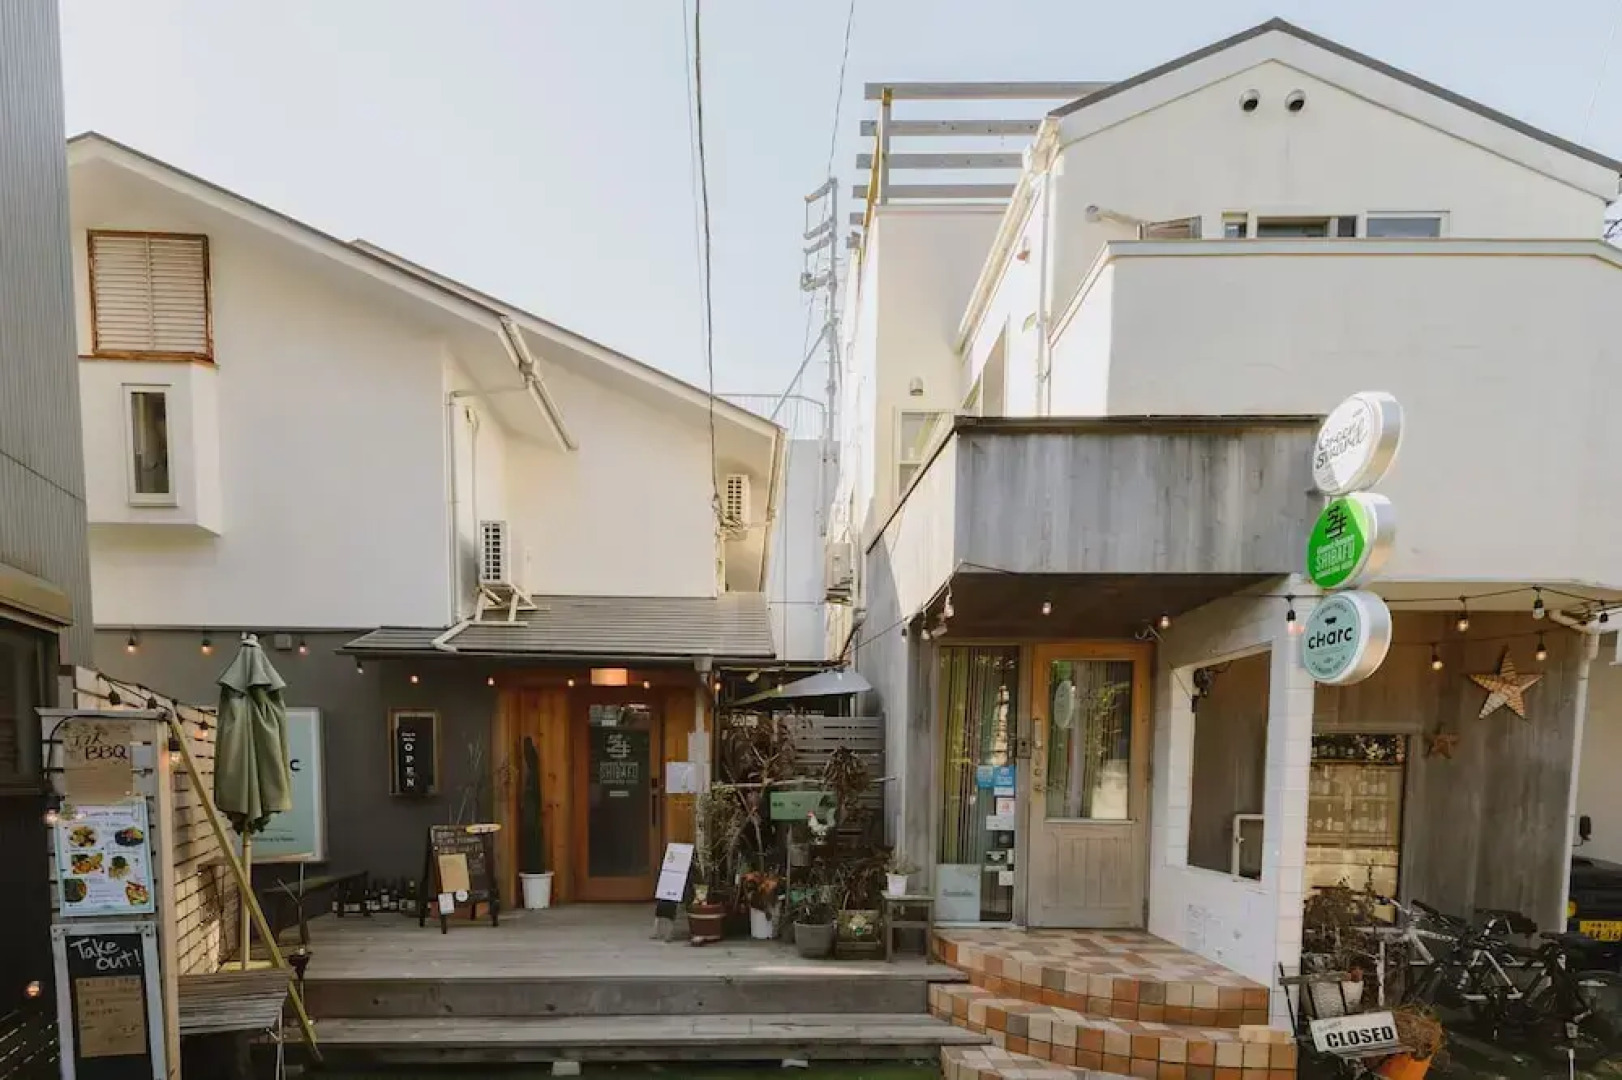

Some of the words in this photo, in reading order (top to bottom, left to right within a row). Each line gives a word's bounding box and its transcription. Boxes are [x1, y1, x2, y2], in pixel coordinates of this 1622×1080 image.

[85, 743, 129, 760] BBQ
[404, 742, 415, 788] OPEN
[69, 937, 121, 960] Take
[1325, 1025, 1394, 1048] CLOSED
